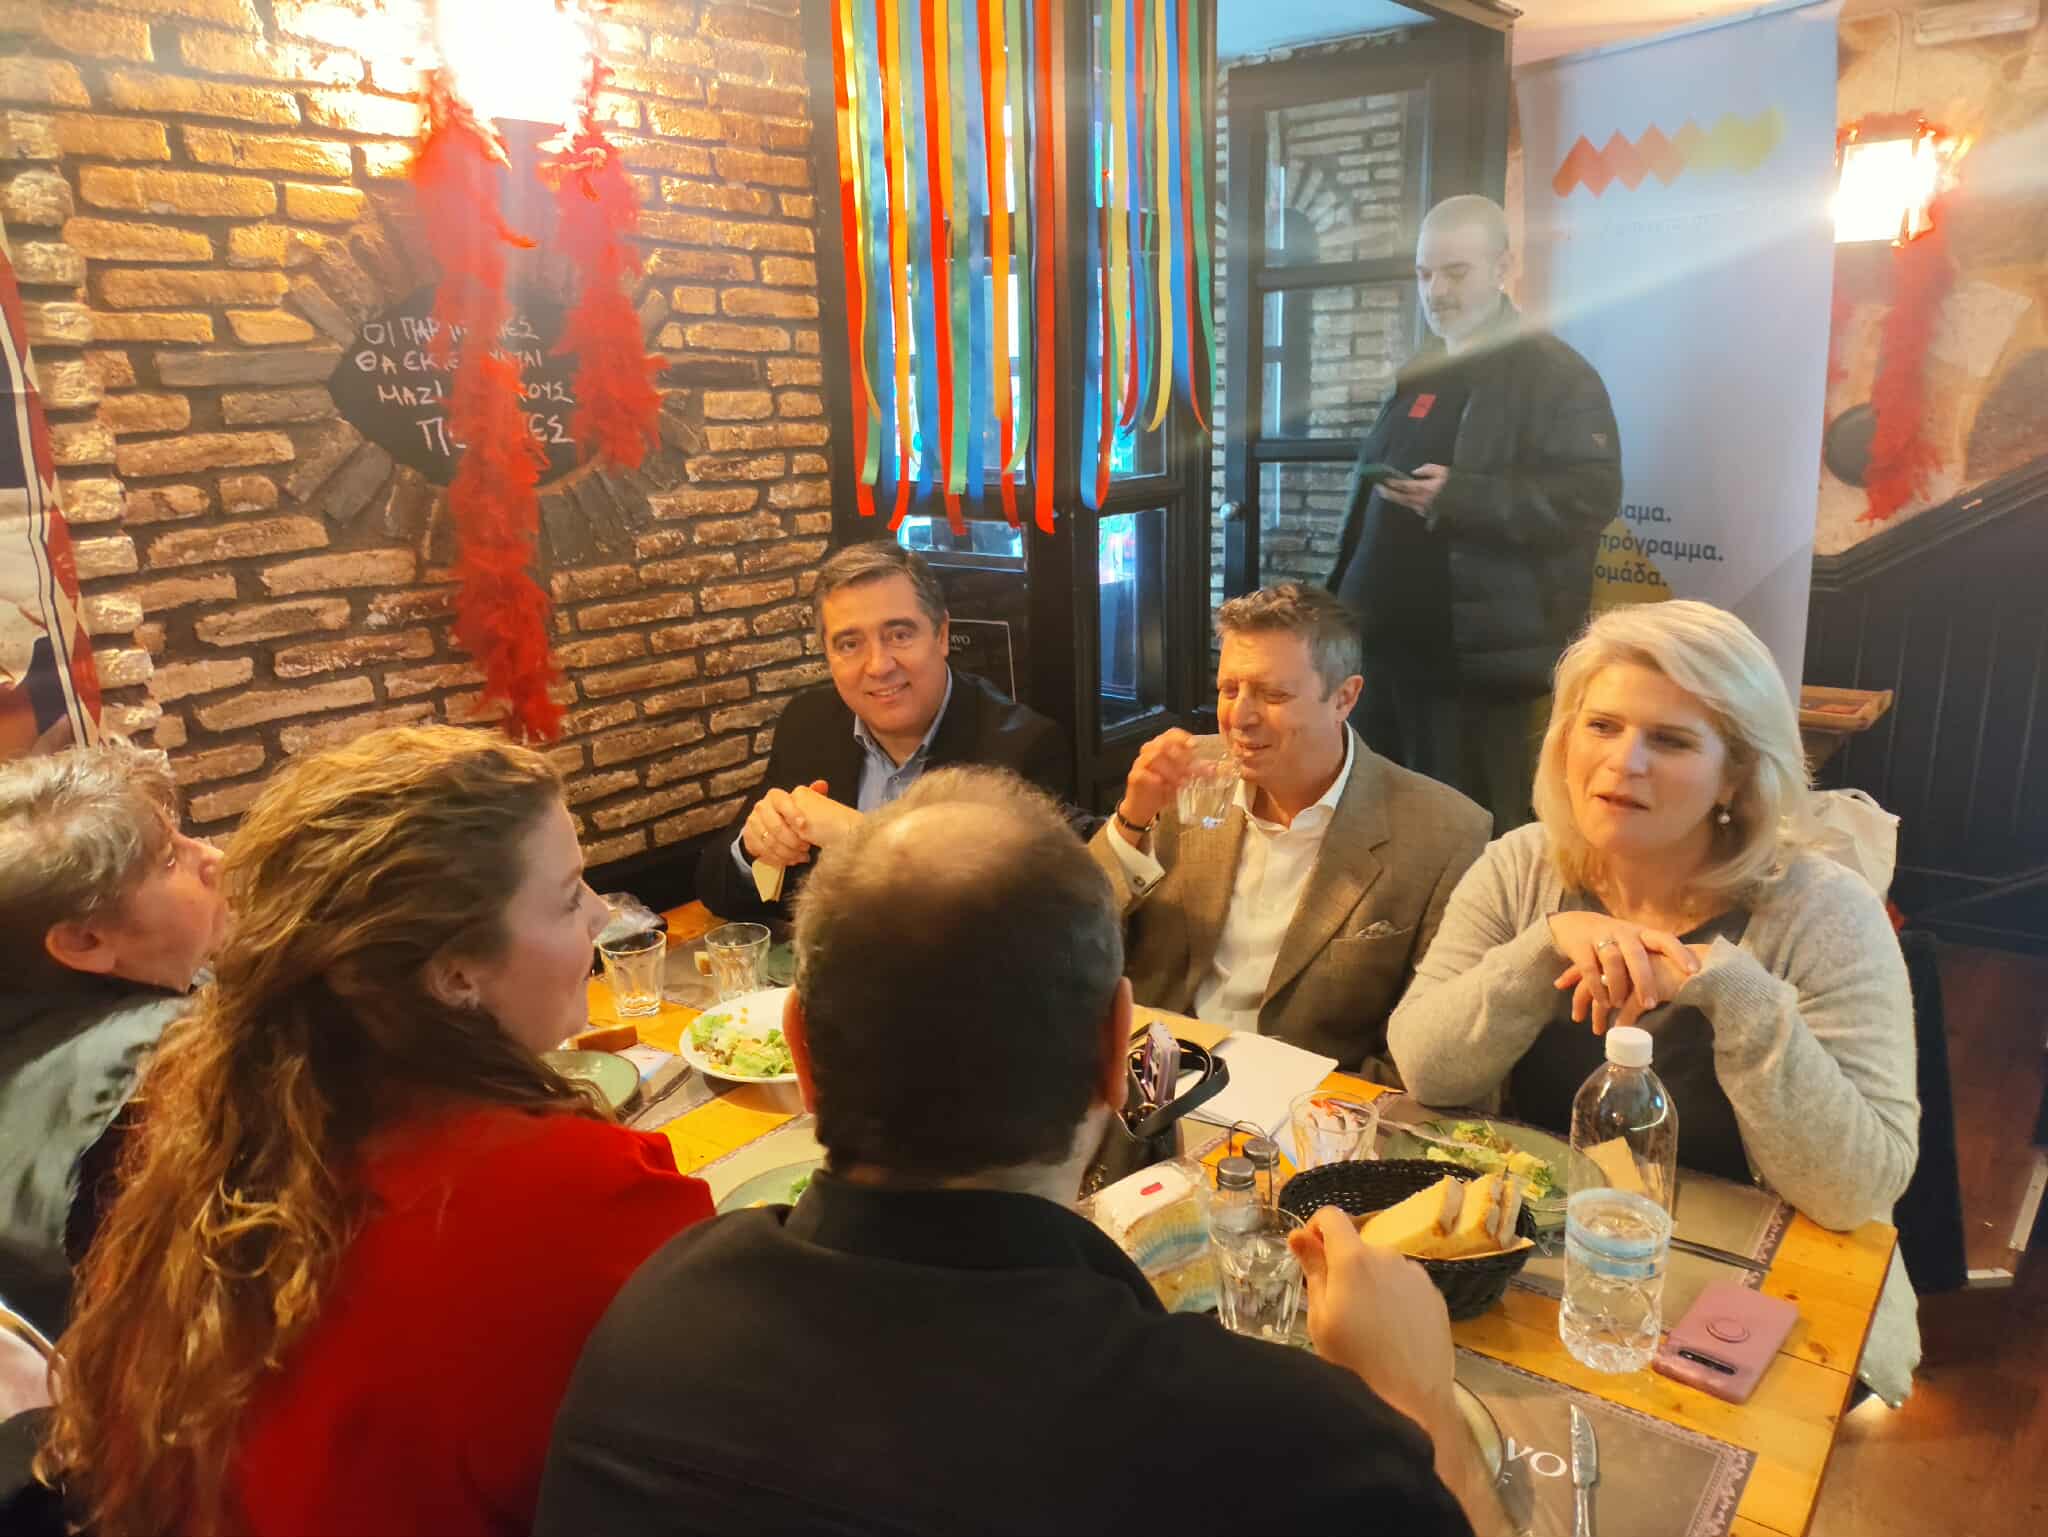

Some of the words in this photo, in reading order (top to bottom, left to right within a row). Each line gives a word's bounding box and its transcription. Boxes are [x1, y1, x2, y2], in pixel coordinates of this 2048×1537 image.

[362, 321, 396, 347] ΟΙ
[355, 350, 398, 376] ΘΑ
[377, 379, 443, 406] ΜΑΖΙ
[1600, 528, 1724, 564] πρόγραμμα.
[1594, 559, 1667, 587] ομάδα.
